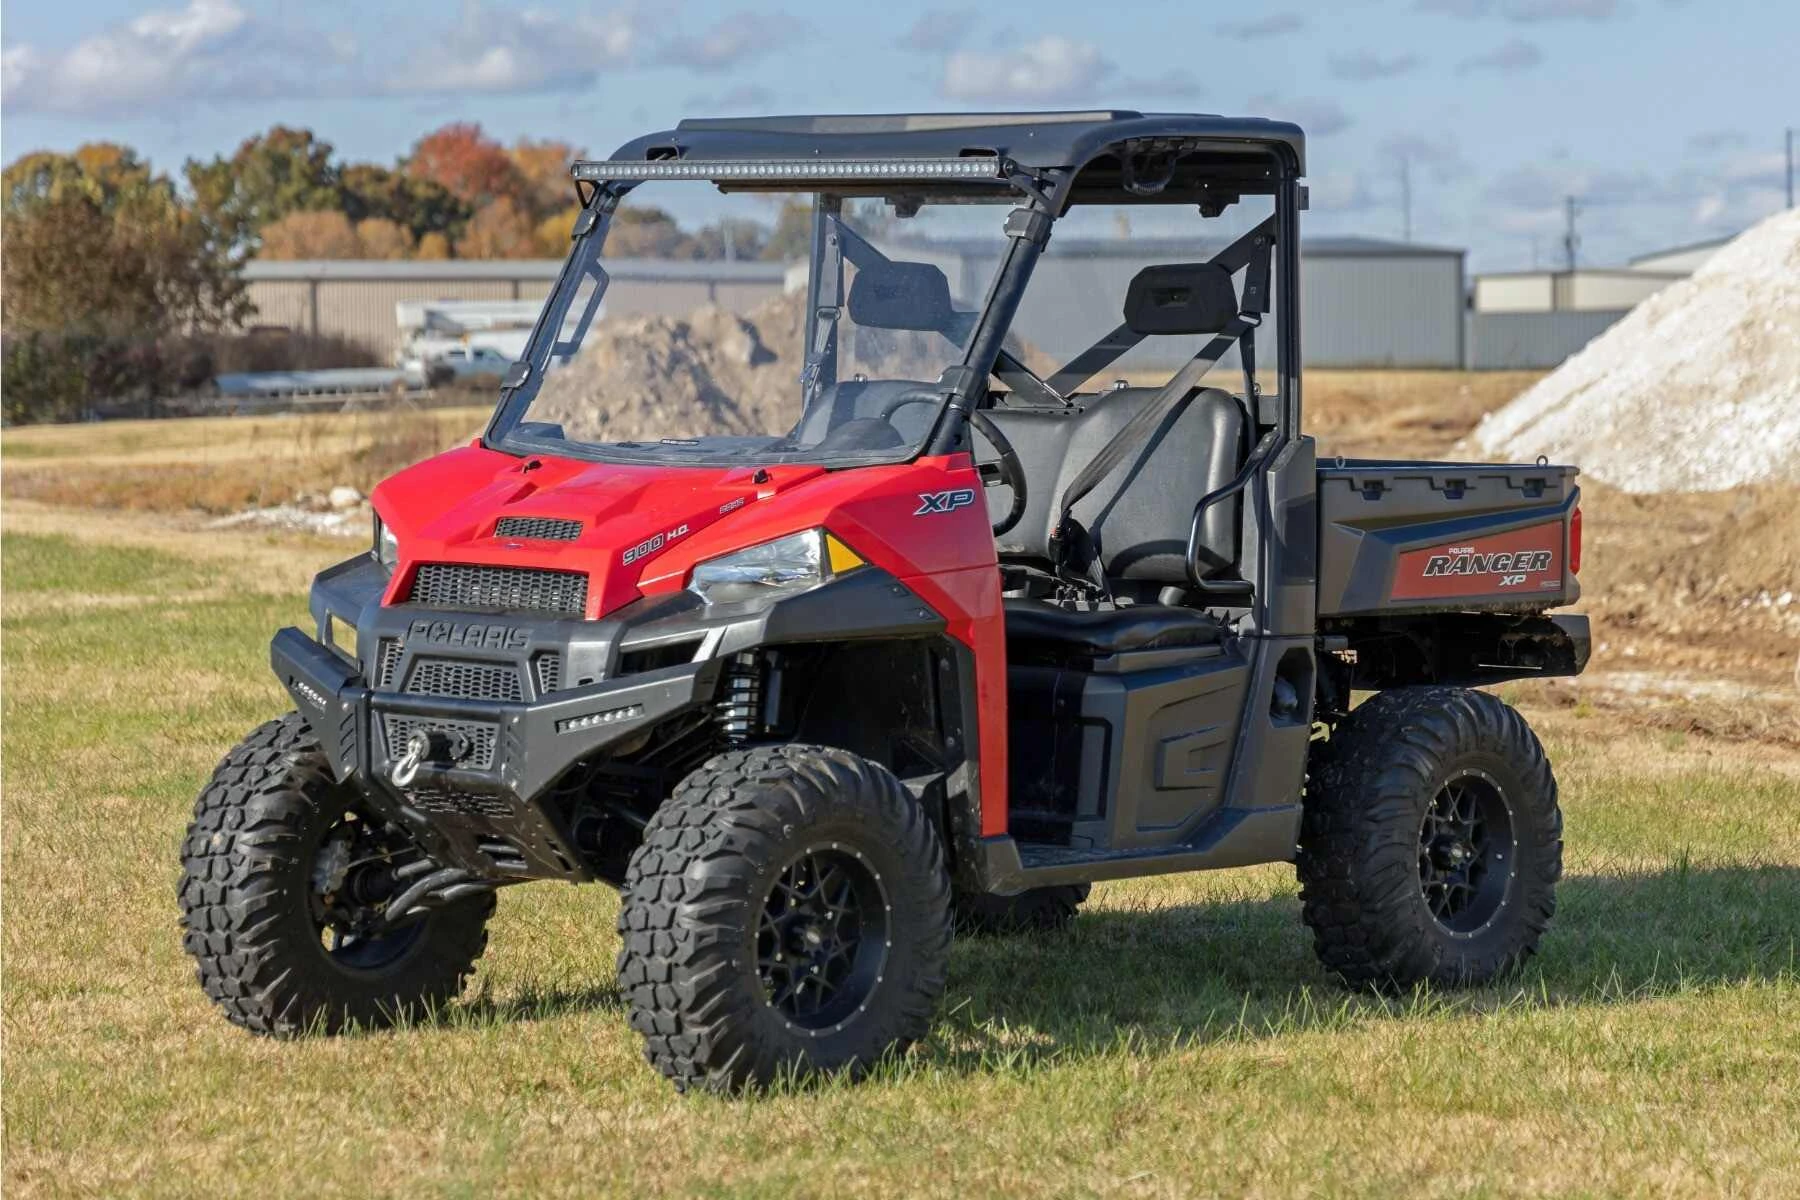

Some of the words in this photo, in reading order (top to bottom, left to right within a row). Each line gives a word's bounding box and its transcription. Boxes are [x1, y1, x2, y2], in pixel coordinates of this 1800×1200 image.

[913, 489, 974, 515] XP
[623, 534, 664, 566] 900
[1422, 551, 1552, 576] RANGER
[1499, 575, 1526, 586] XP
[407, 620, 533, 649] POLARIS
